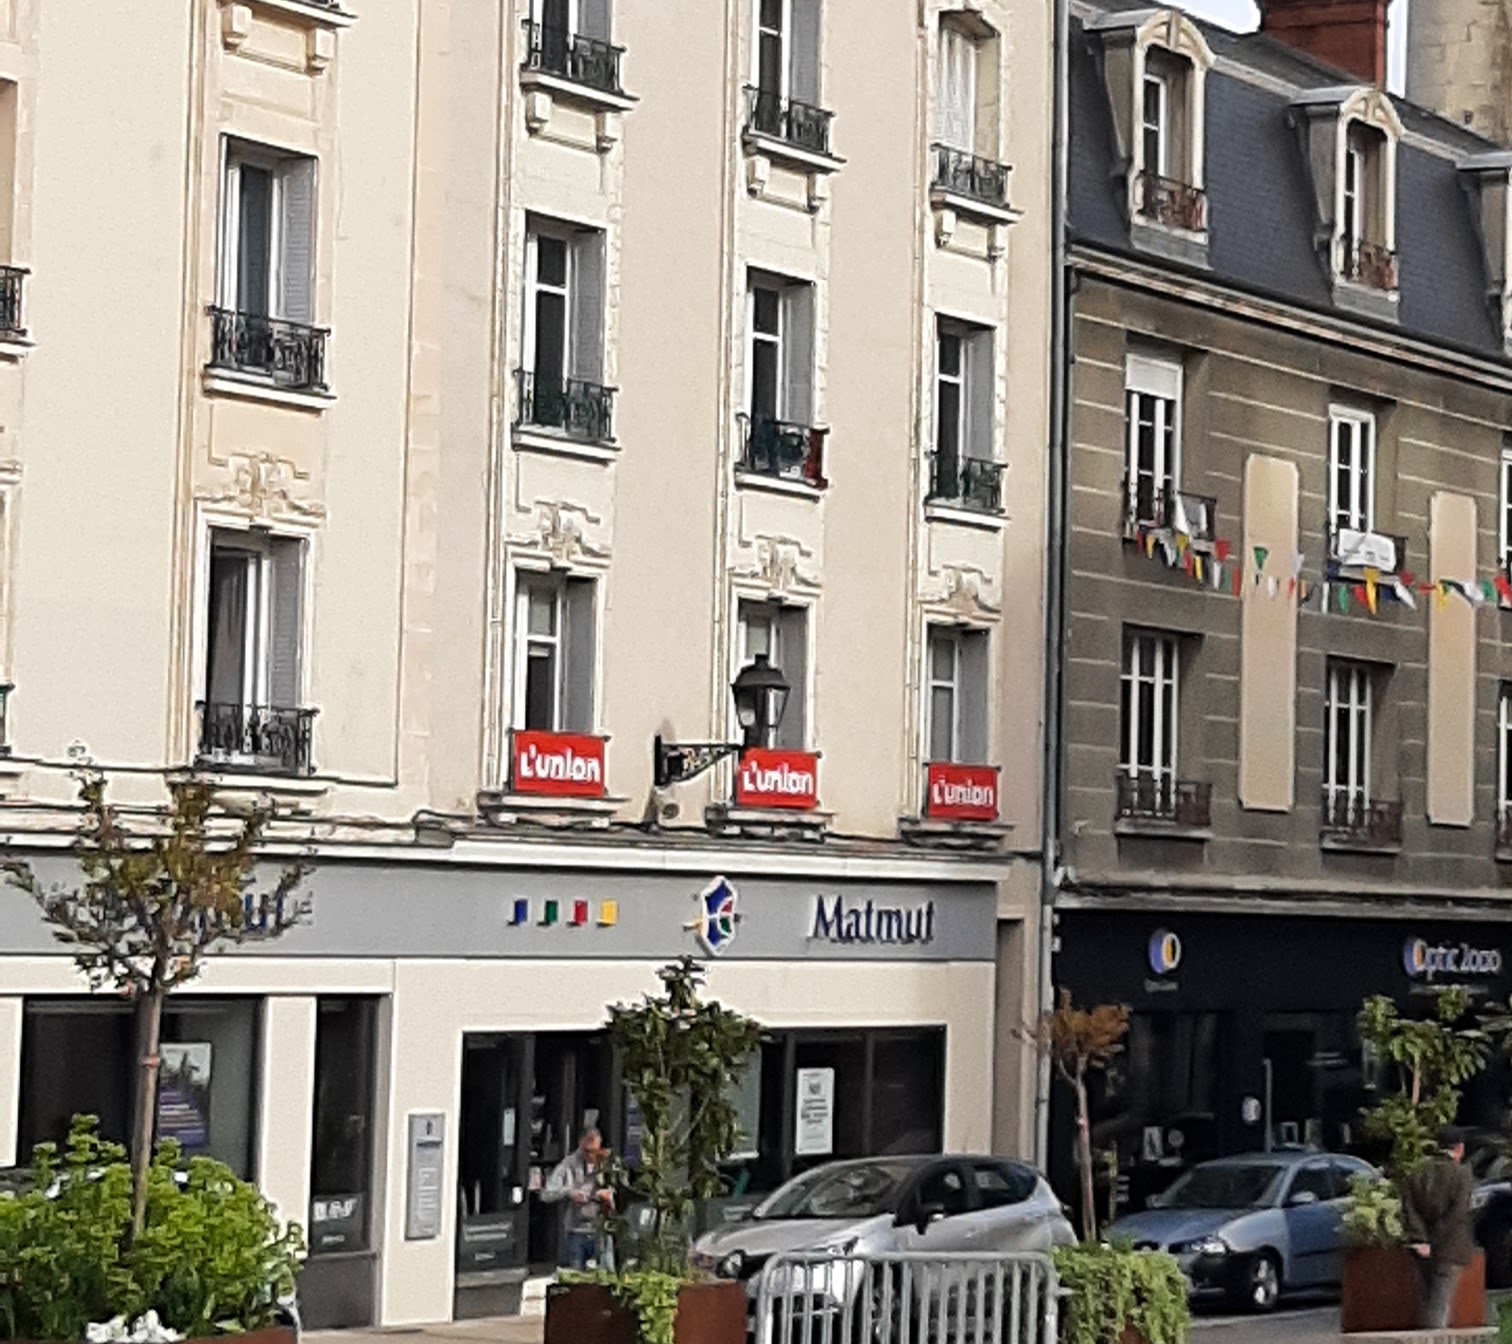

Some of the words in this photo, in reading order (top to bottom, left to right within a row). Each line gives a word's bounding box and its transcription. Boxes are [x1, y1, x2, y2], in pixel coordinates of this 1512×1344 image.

[520, 744, 601, 782] L'union
[742, 761, 814, 795] L'union
[932, 776, 995, 806] L'union
[811, 894, 935, 945] Matmut
